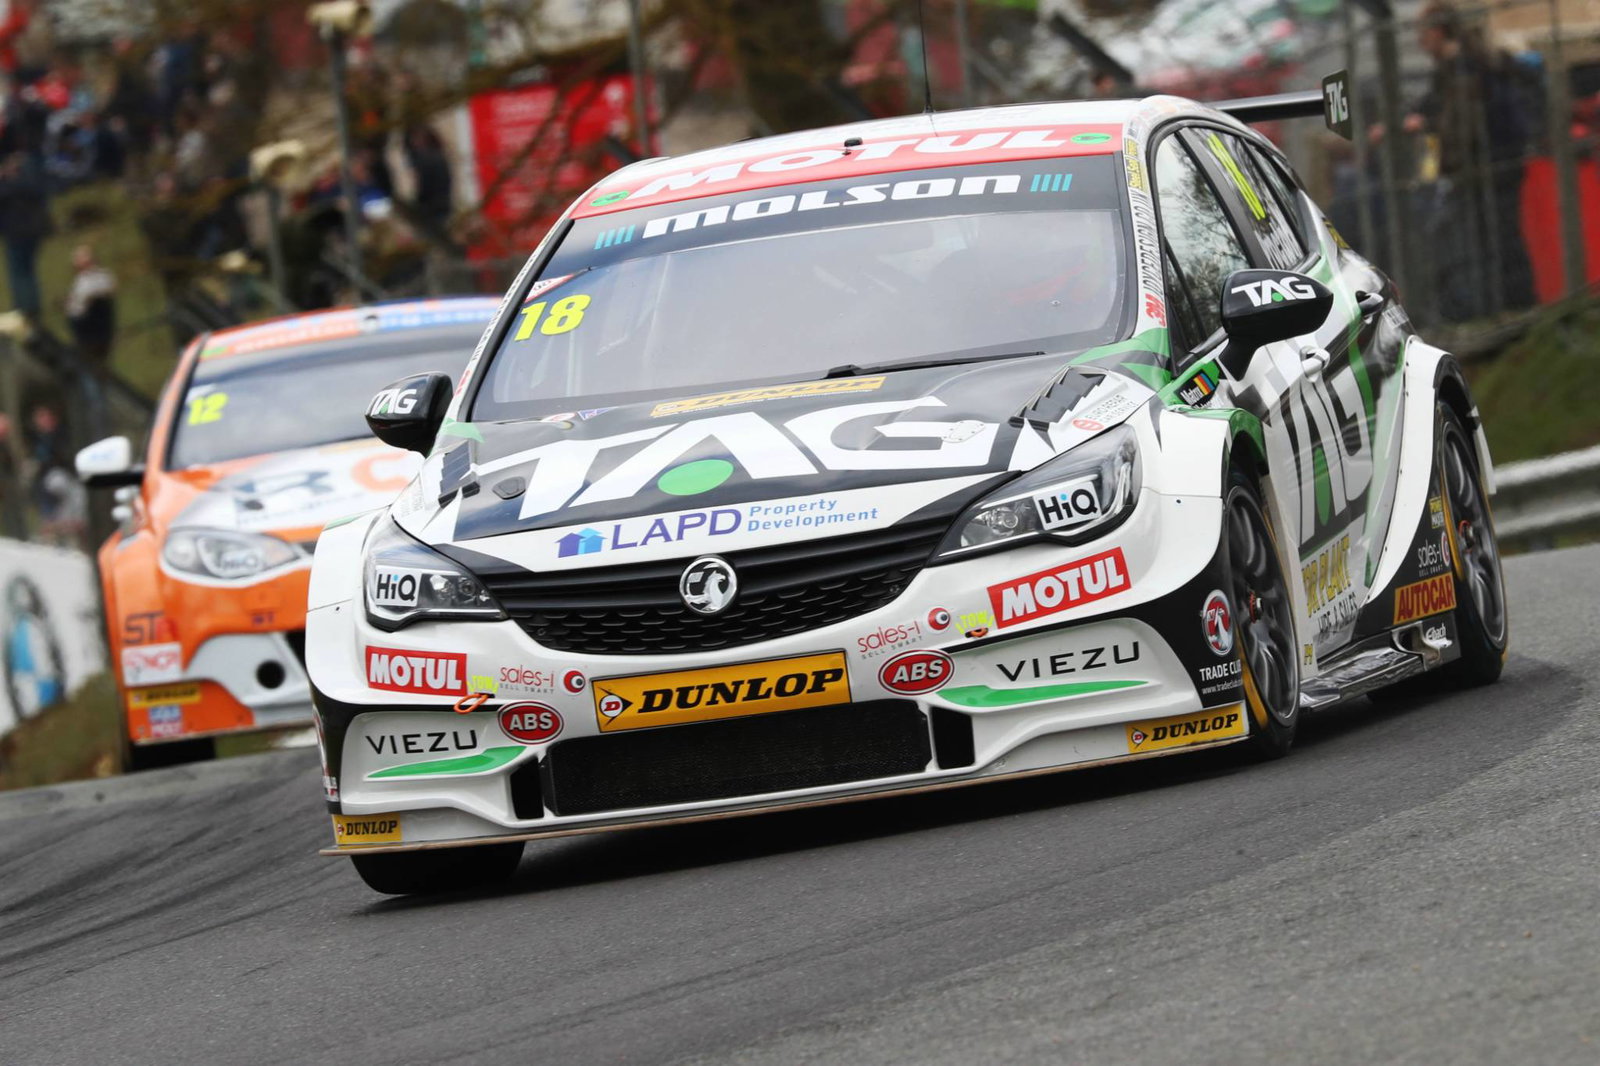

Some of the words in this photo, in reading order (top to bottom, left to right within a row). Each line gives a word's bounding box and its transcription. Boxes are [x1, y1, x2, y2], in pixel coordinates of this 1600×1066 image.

[1326, 81, 1349, 125] TAG
[626, 130, 1067, 200] MOTUL
[1231, 276, 1317, 307] TAG
[514, 294, 592, 341] 18
[187, 392, 228, 426] 12
[365, 389, 418, 417] TAG
[475, 395, 1001, 521] TAG
[747, 507, 879, 533] Development
[749, 498, 838, 518] Property
[1039, 489, 1098, 524] HiQ
[611, 508, 742, 551] LAPD
[377, 573, 416, 601] HiQ
[1002, 556, 1123, 621] MOTUL
[1397, 575, 1455, 622] AUTOCAR
[960, 610, 988, 629] TOW
[861, 648, 885, 660] SELL
[891, 635, 922, 650] SMART
[997, 641, 1140, 681] VIEZU
[369, 653, 462, 690] MOTUL
[500, 664, 554, 688] sales-i
[891, 659, 944, 684] ABS
[1199, 663, 1229, 682] TRADE
[637, 668, 844, 714] DUNLOP
[510, 712, 553, 731] ABS
[1151, 713, 1239, 742] DUNLOP
[365, 729, 478, 754] VIEZU
[346, 820, 398, 836] DUNLOP
